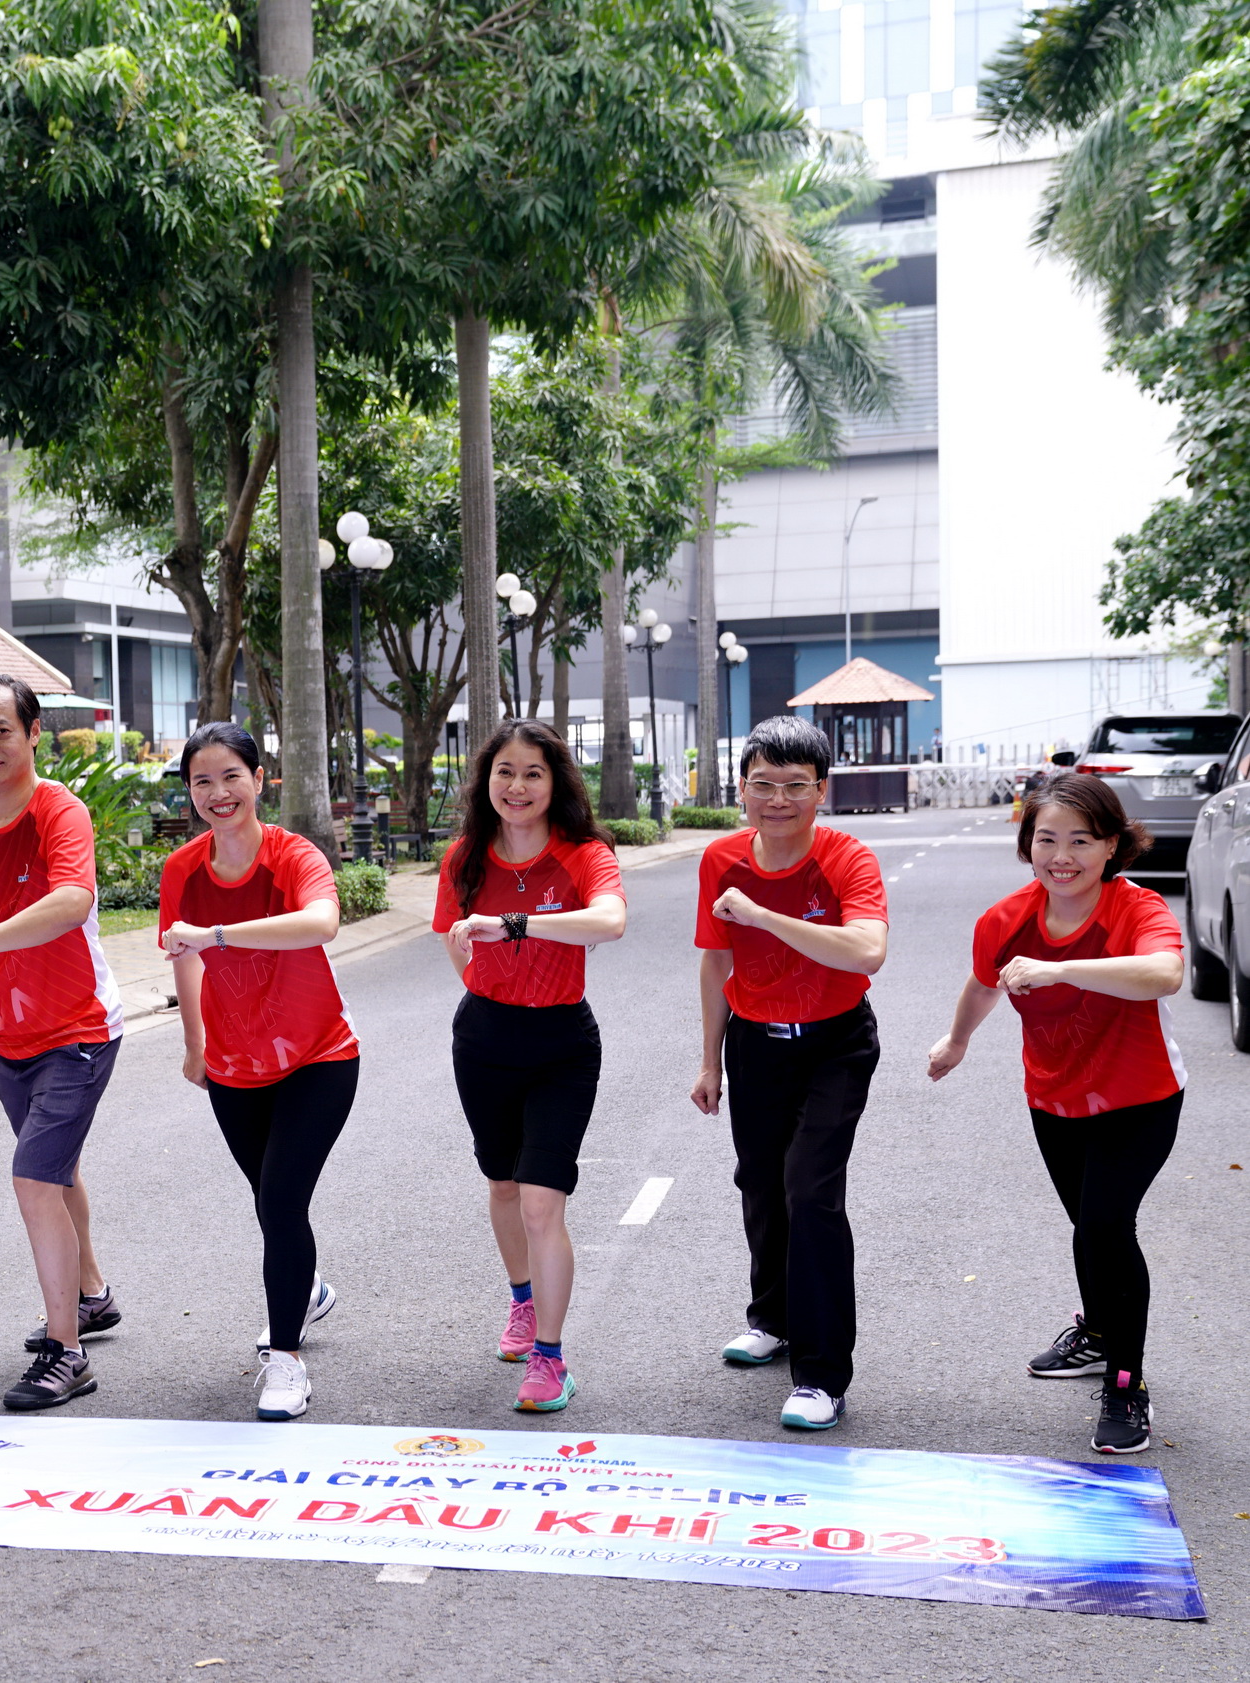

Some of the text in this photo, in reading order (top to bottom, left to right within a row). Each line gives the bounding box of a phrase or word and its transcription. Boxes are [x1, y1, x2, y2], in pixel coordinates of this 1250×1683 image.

[326, 1471, 479, 1491] CHẠY
[492, 1478, 568, 1497] BỘ
[623, 1471, 673, 1479] NAM
[295, 1494, 509, 1532] DẦU
[534, 1509, 729, 1544] KHÍ
[746, 1523, 1007, 1563] 2023
[637, 1551, 802, 1571] 16/4/2023
